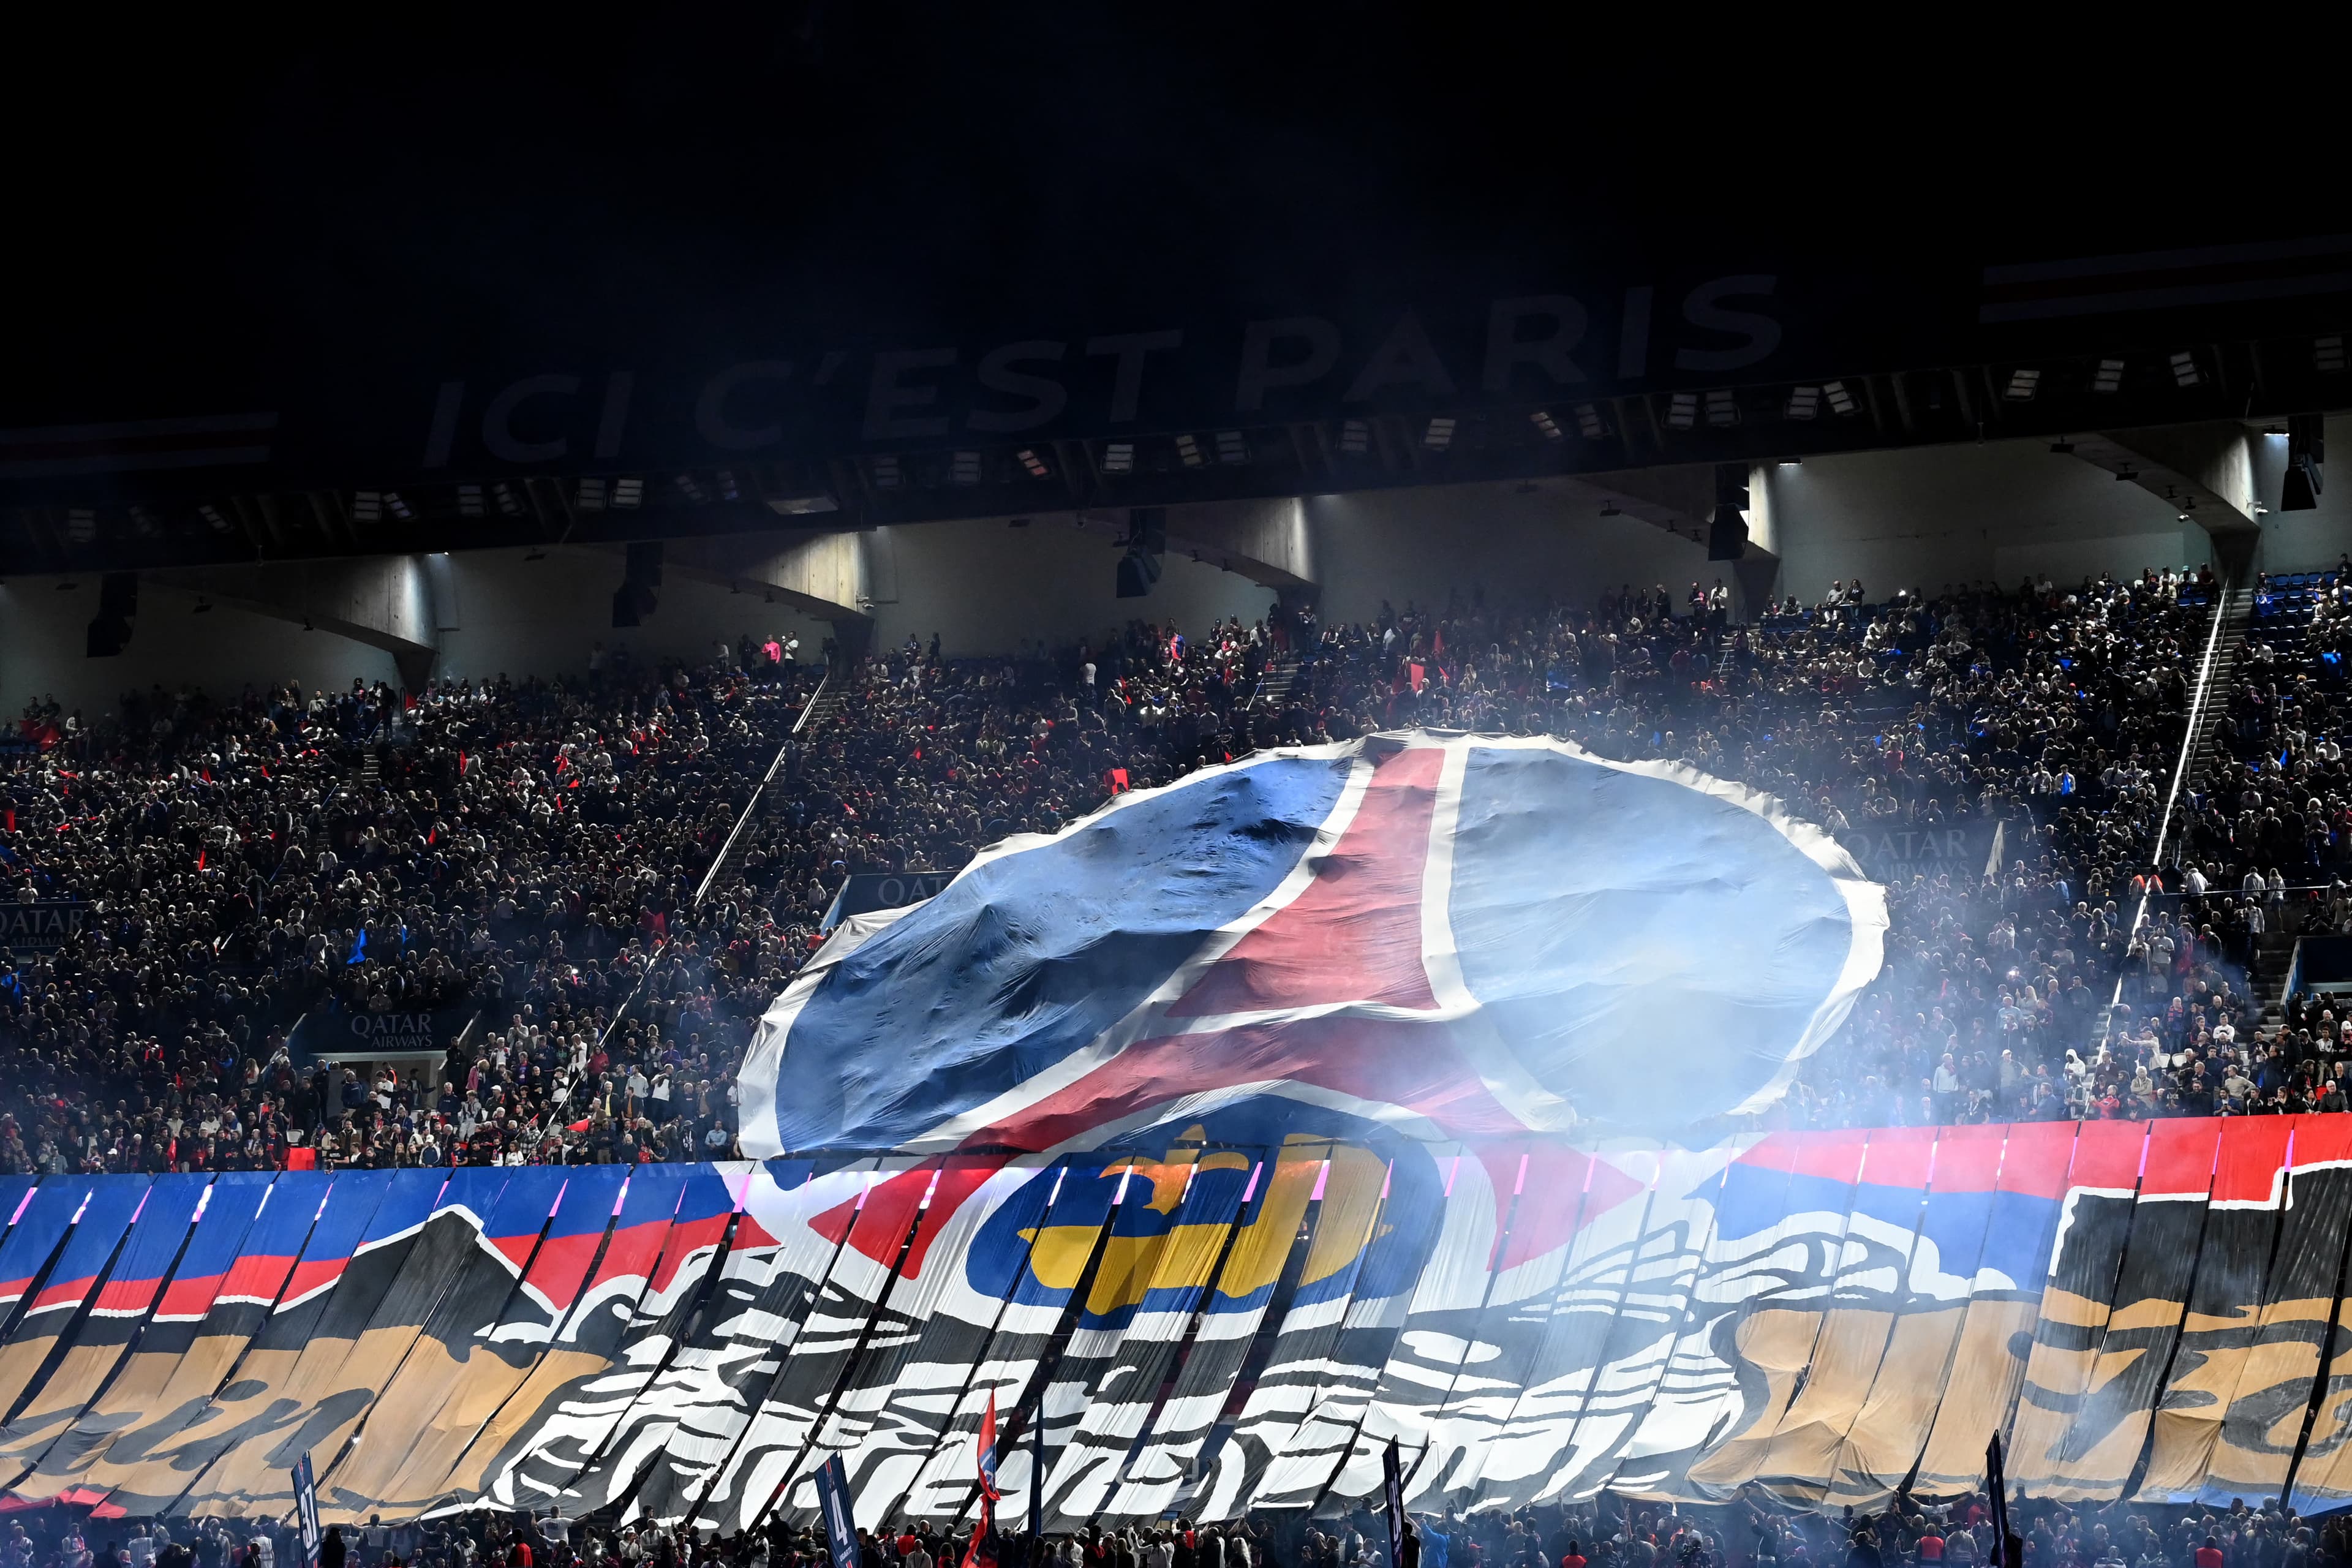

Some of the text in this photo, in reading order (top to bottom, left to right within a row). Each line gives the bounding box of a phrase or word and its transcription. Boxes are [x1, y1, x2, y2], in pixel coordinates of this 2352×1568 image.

[421, 274, 1784, 469] ICI C'EST PARIS
[1842, 829, 1969, 866] QATAR
[878, 877, 948, 907] QAT
[351, 1014, 432, 1039] QATAR
[371, 1035, 432, 1048] AIRWAYS
[831, 1488, 848, 1545] 4
